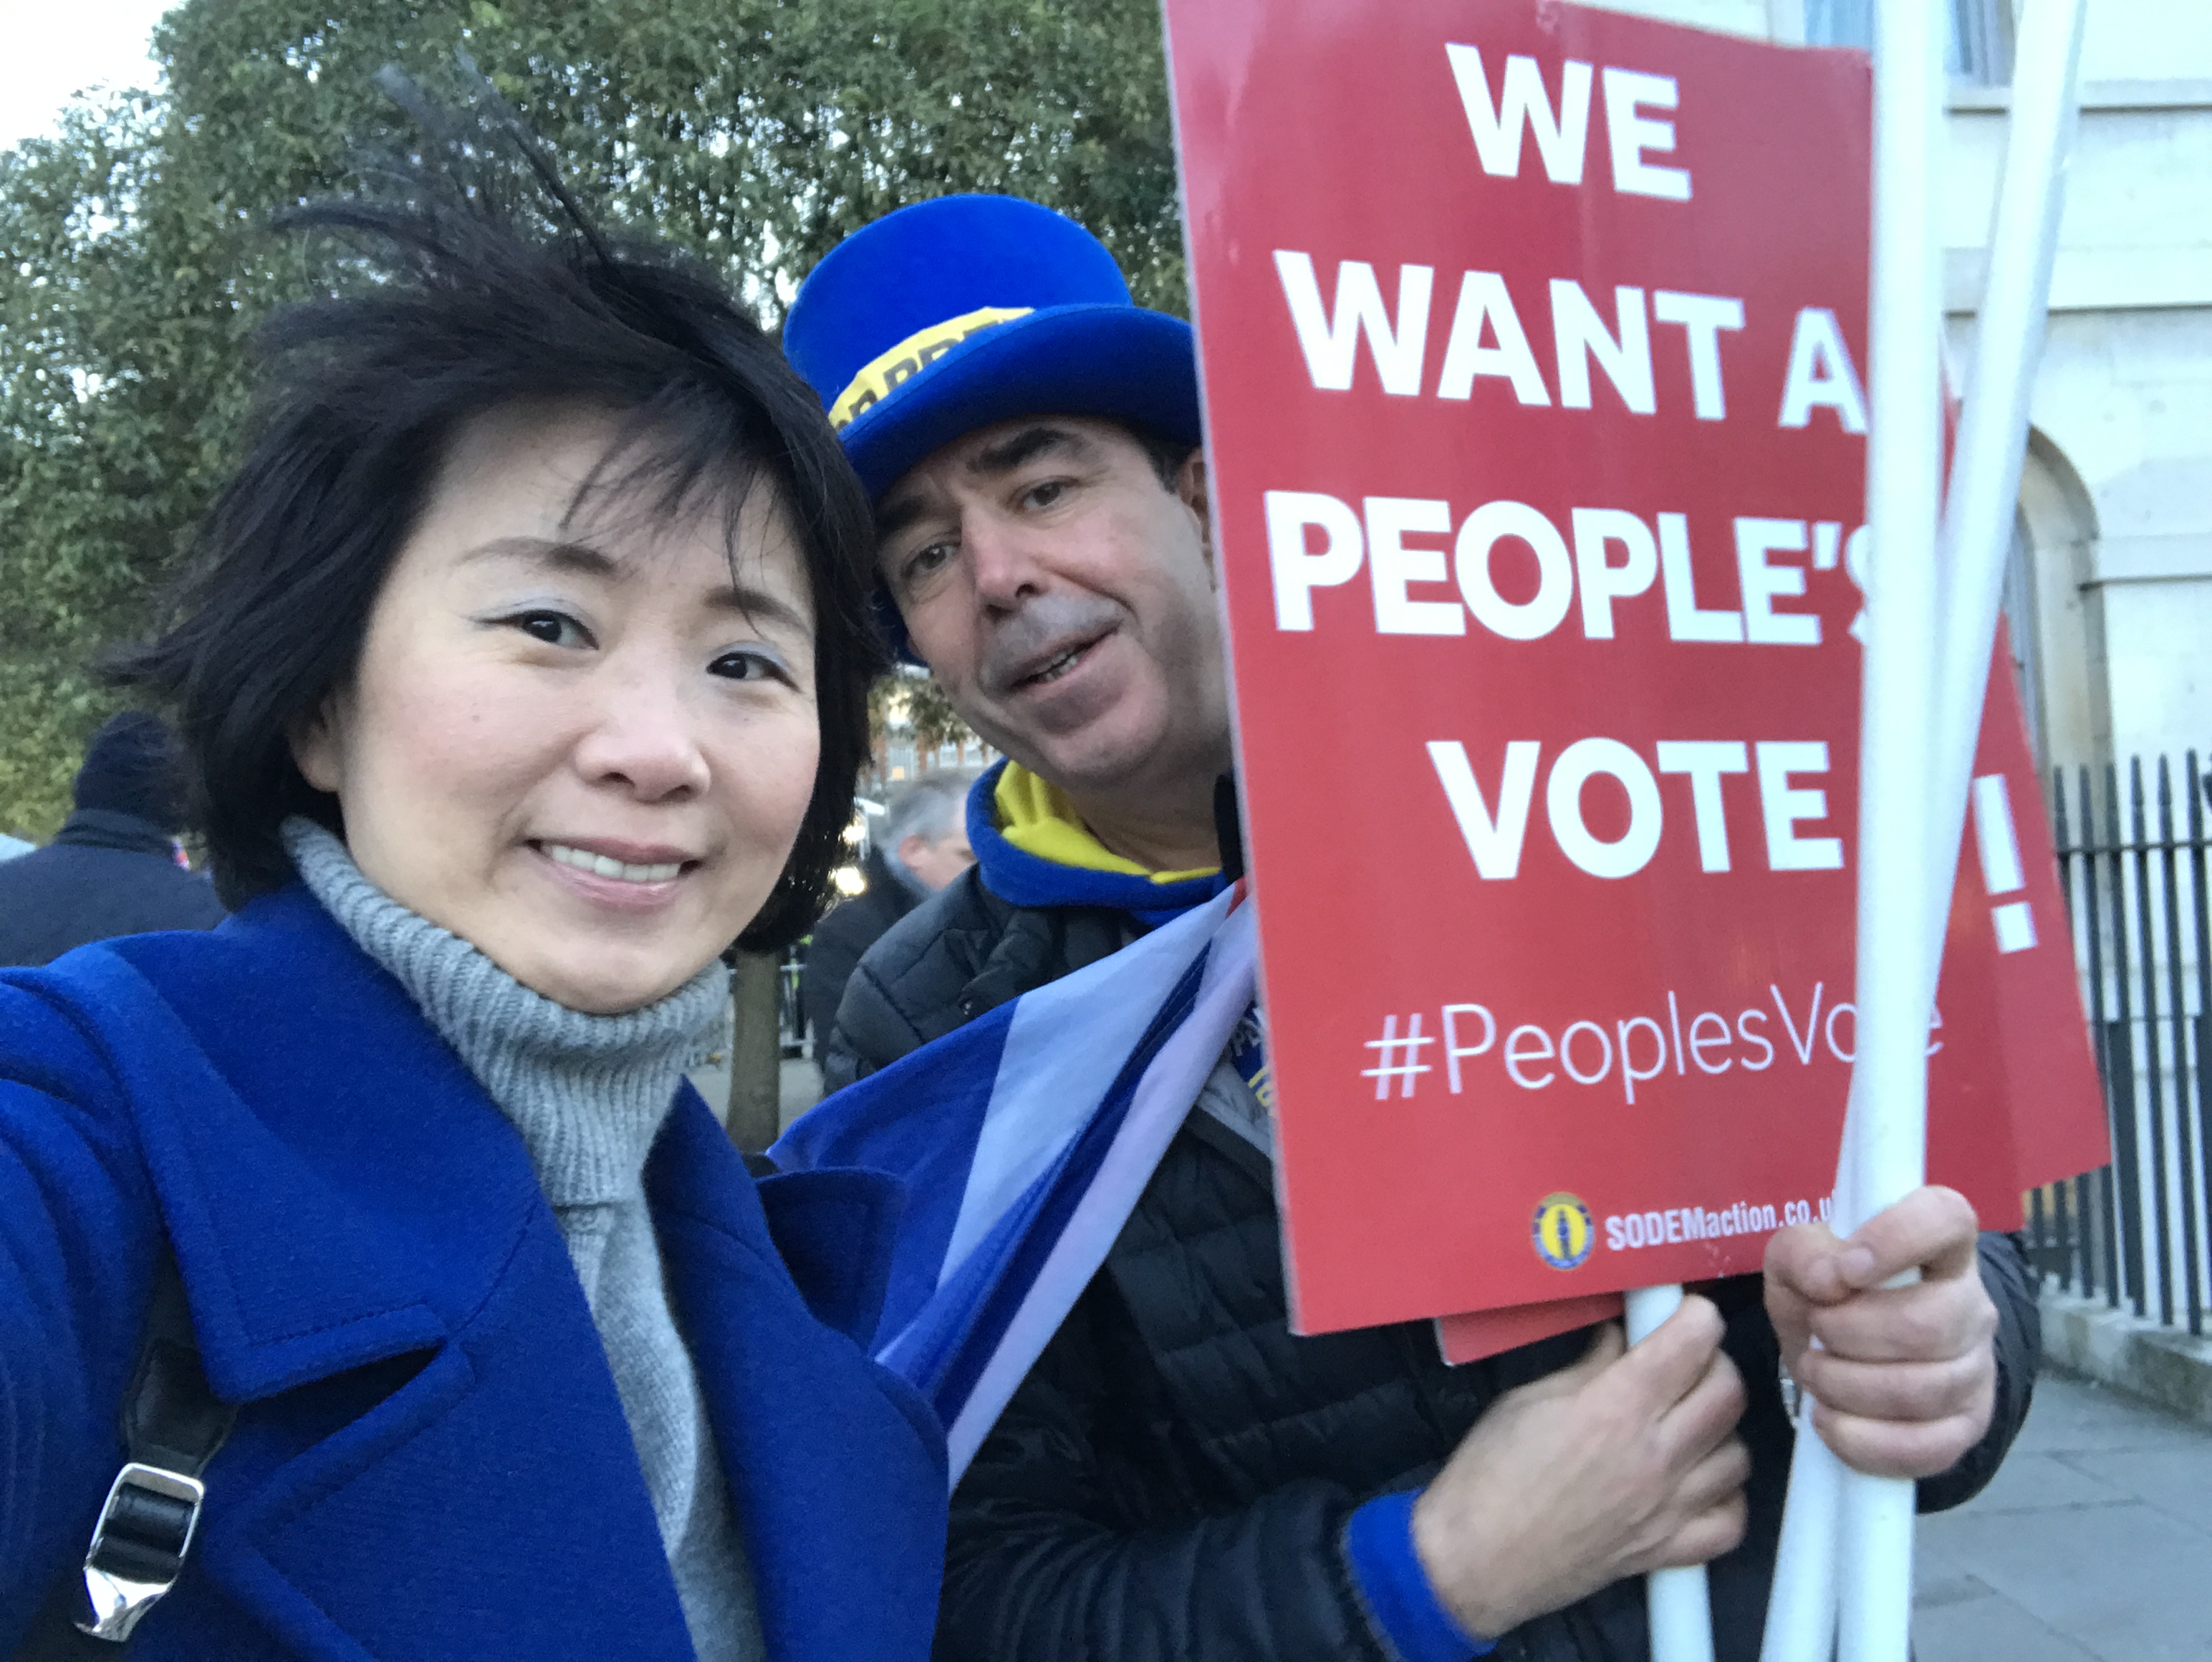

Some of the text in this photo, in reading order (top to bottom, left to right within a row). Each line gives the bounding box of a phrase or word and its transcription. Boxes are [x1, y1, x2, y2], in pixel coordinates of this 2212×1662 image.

[1445, 42, 1693, 201] WE
[1272, 249, 1869, 435] WANT A
[1264, 490, 1868, 646] PEOPLE'
[1425, 736, 1845, 880] VOTE
[1604, 1187, 1837, 1252] SODEMaction.co.u
